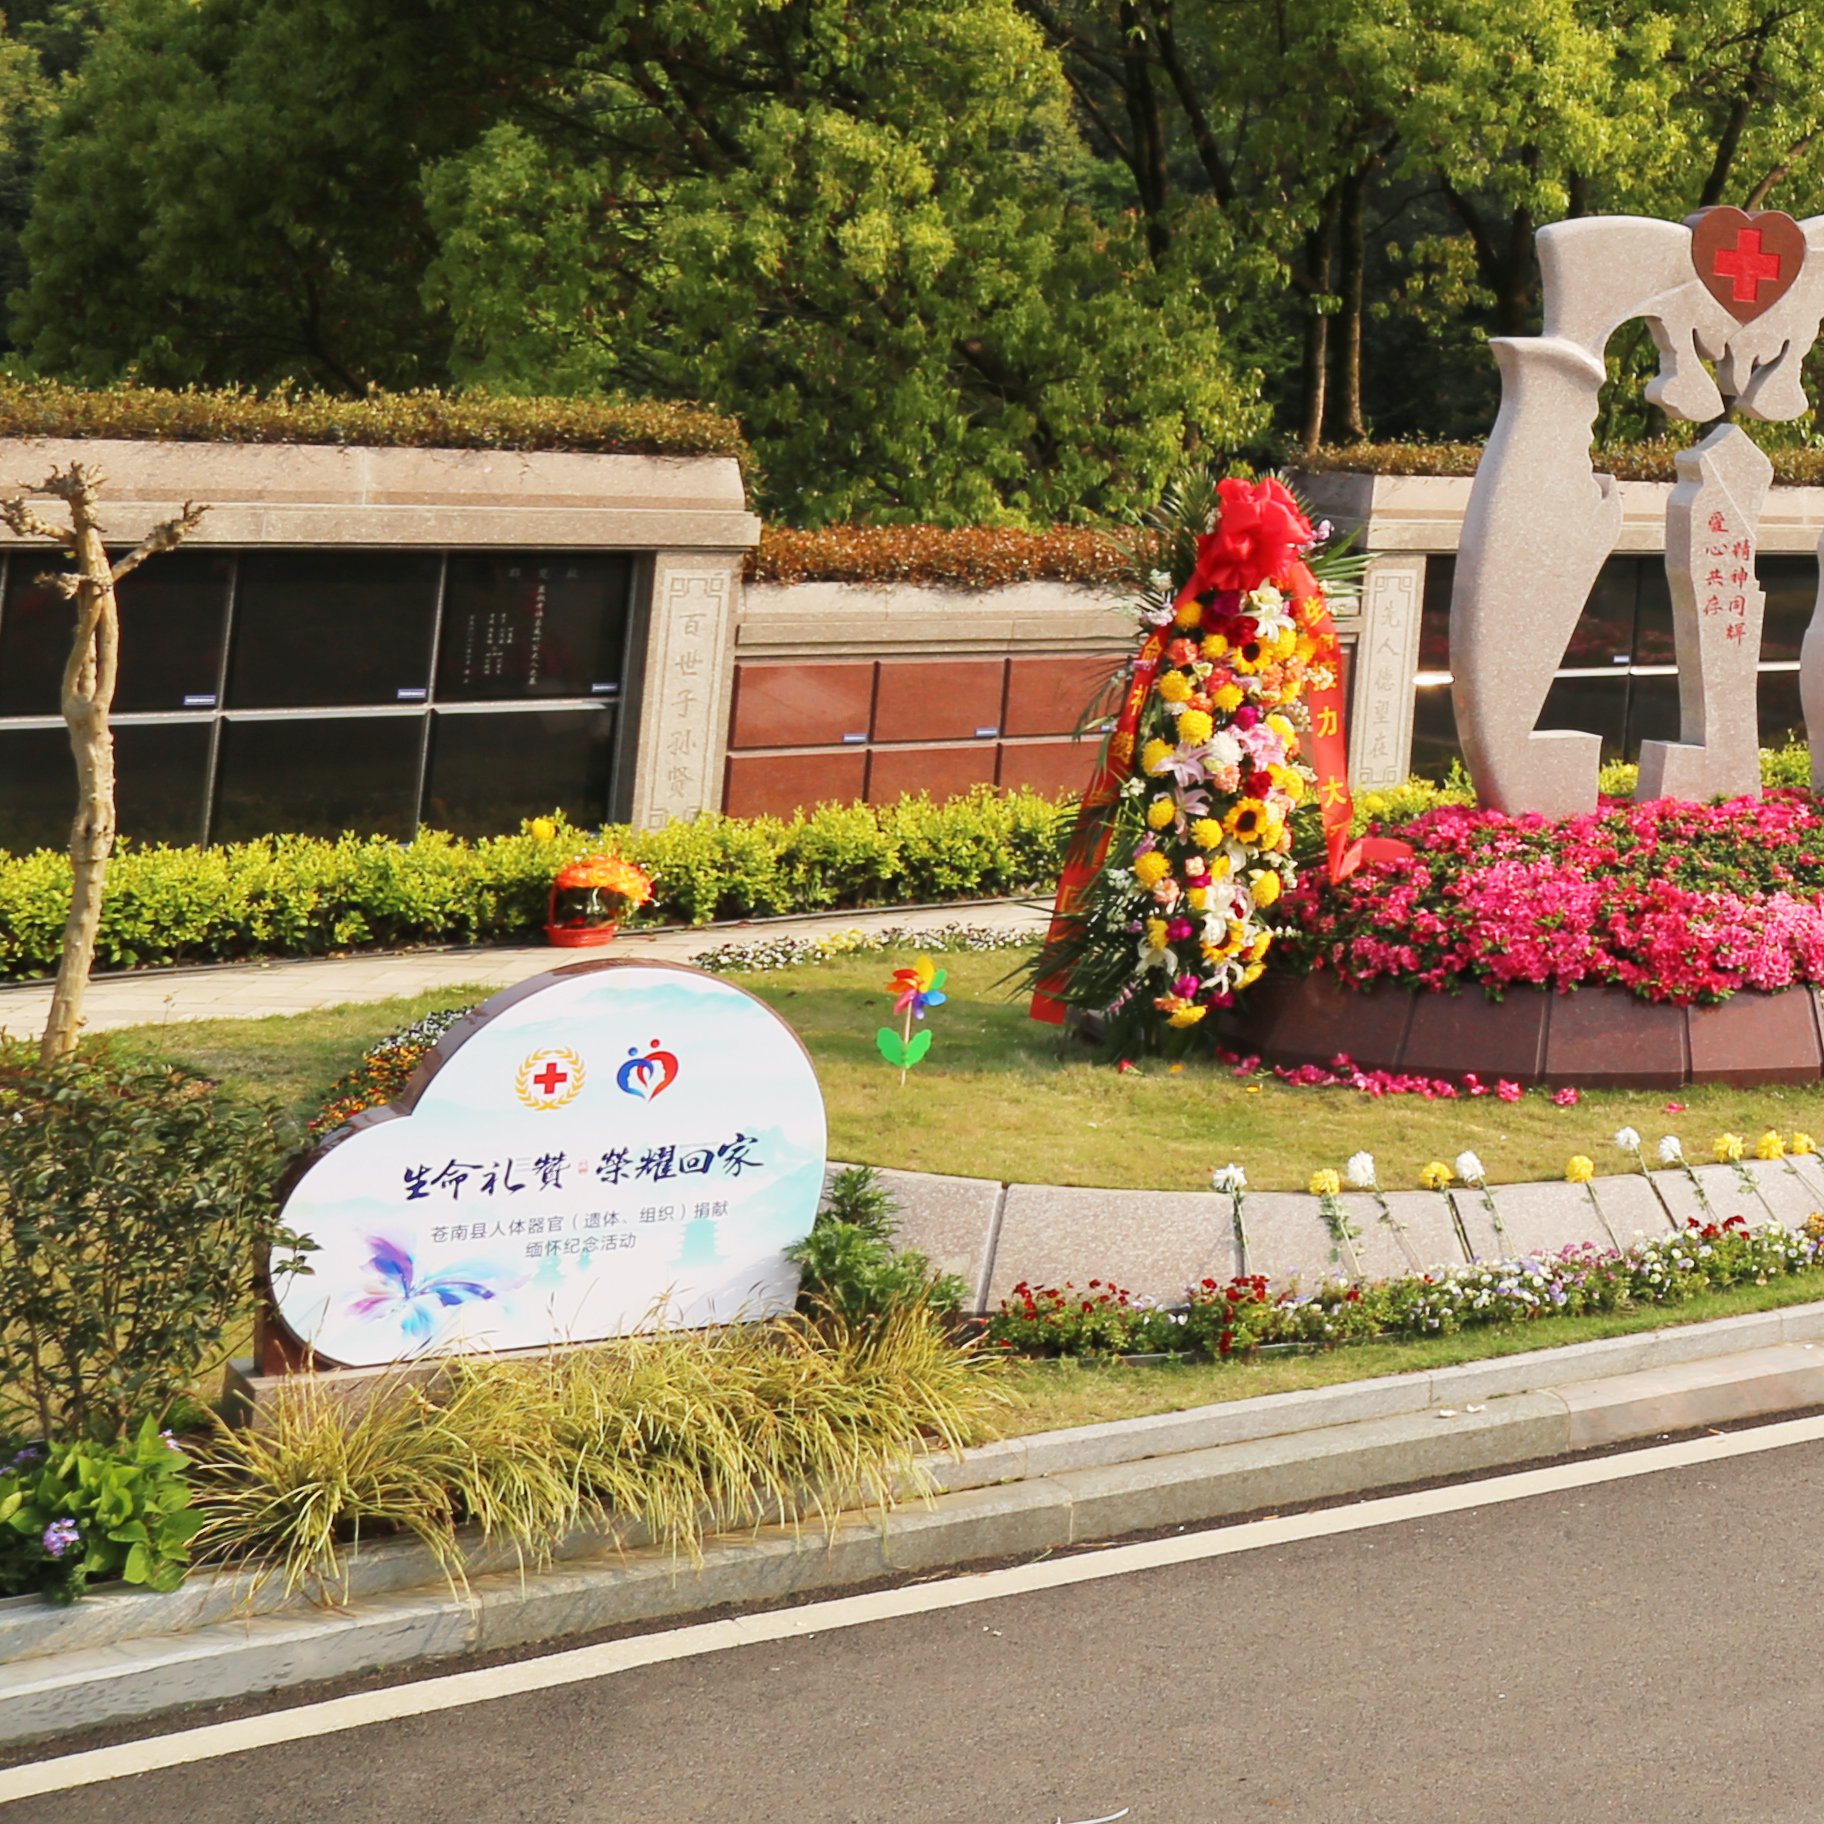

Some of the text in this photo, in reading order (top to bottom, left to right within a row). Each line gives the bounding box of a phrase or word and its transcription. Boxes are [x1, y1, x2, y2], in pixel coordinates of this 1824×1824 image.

[525, 1232, 637, 1259] 缅怀纪念活动
